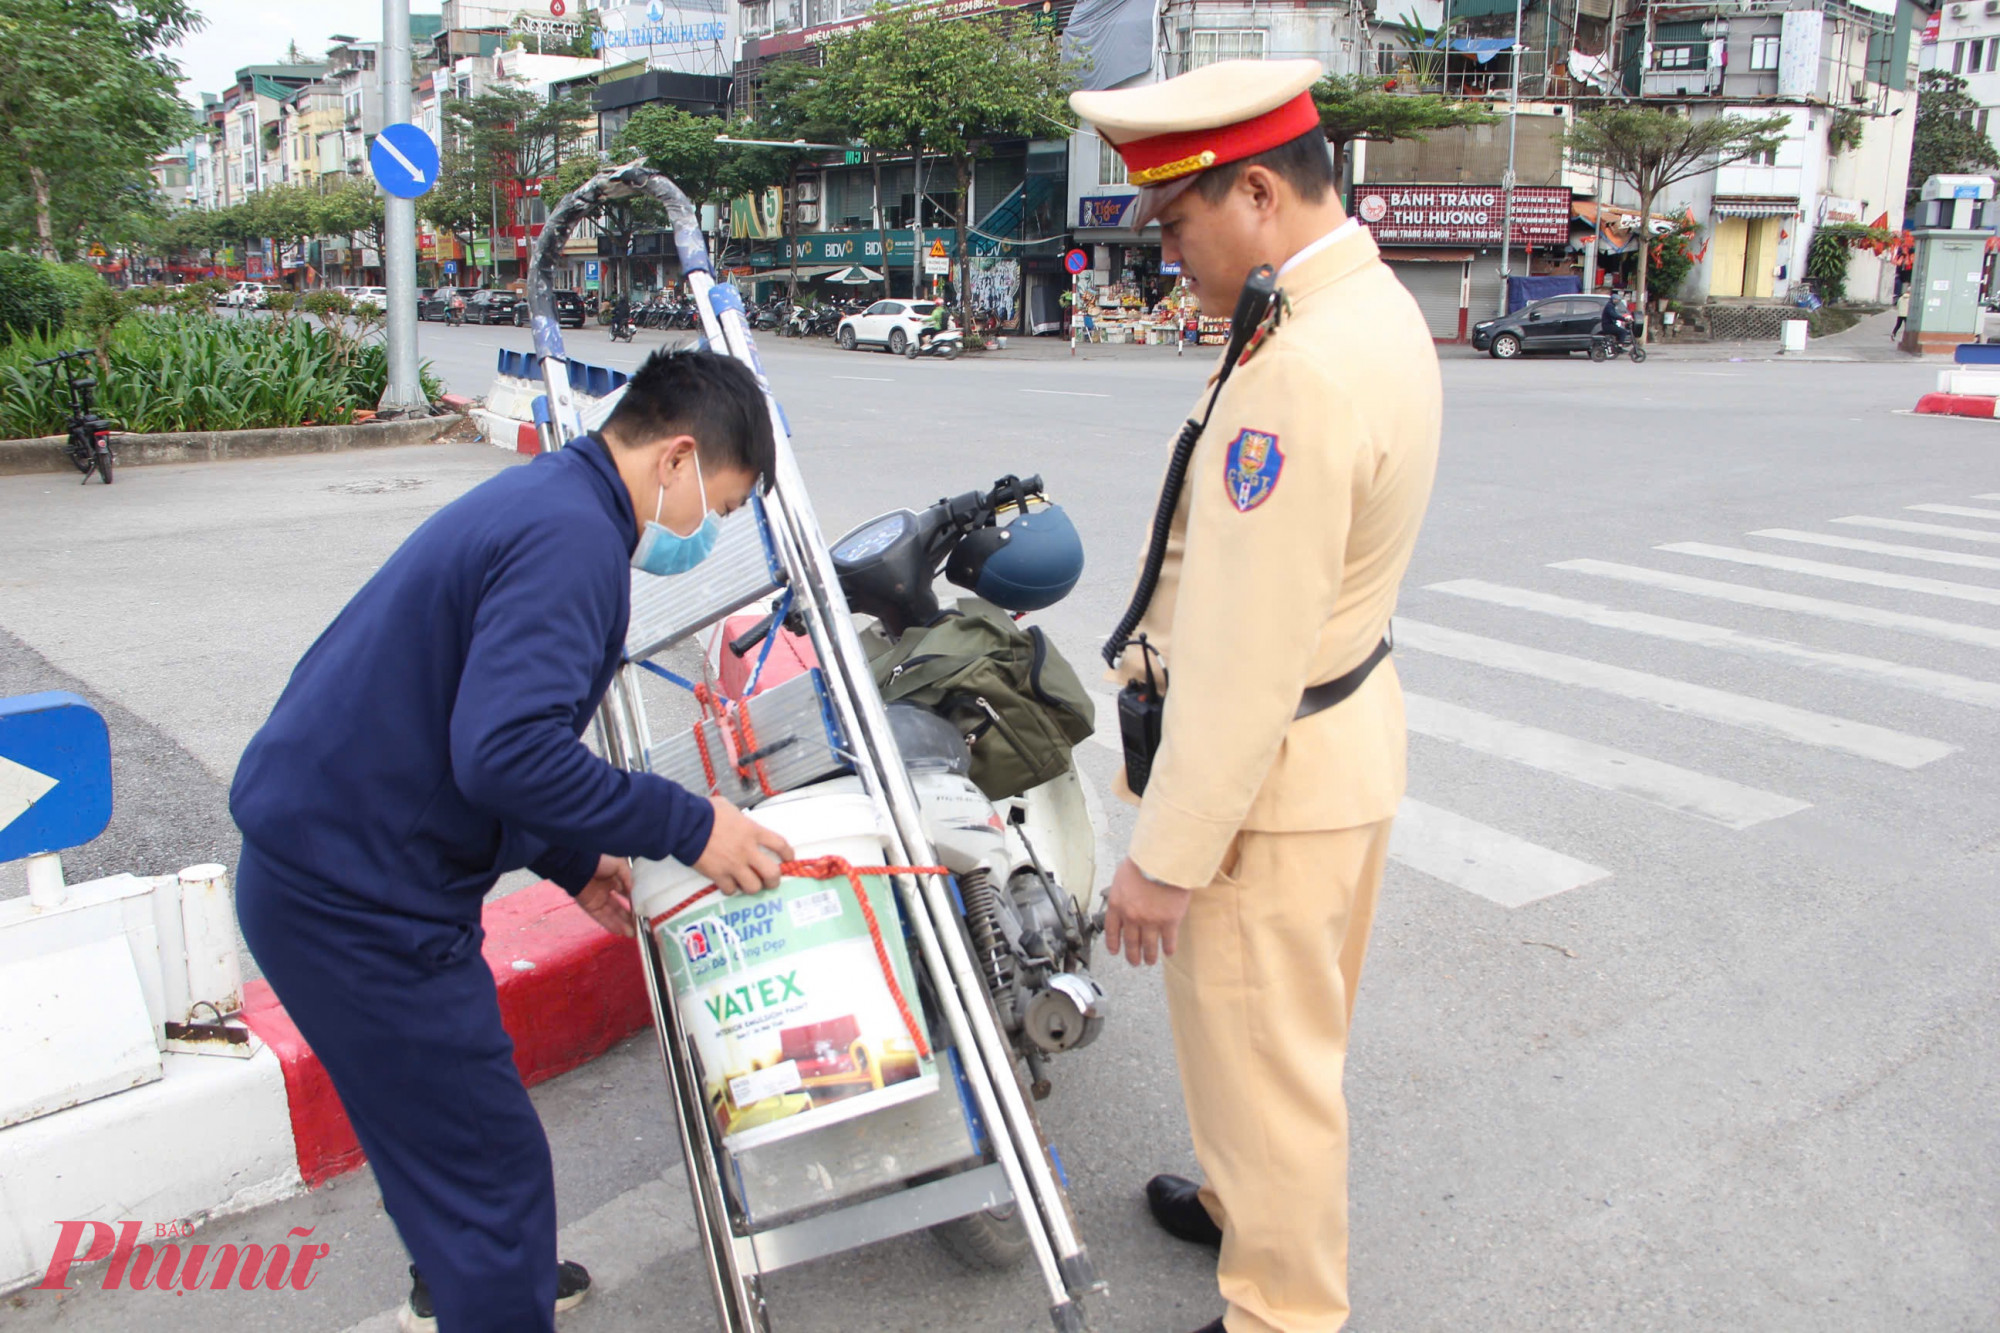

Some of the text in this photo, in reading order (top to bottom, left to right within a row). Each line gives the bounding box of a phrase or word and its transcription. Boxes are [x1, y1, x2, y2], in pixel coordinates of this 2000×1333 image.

[697, 22, 724, 42] LONG
[1390, 190, 1495, 206] BÁNH TRÁNG
[1094, 200, 1121, 222] Tiger
[1393, 209, 1489, 225] THU HƯƠNG
[786, 244, 804, 258] BDV
[825, 243, 846, 258] BIDV
[588, 263, 596, 275] P
[723, 918, 773, 944] AINT
[704, 970, 804, 1022] VATEX
